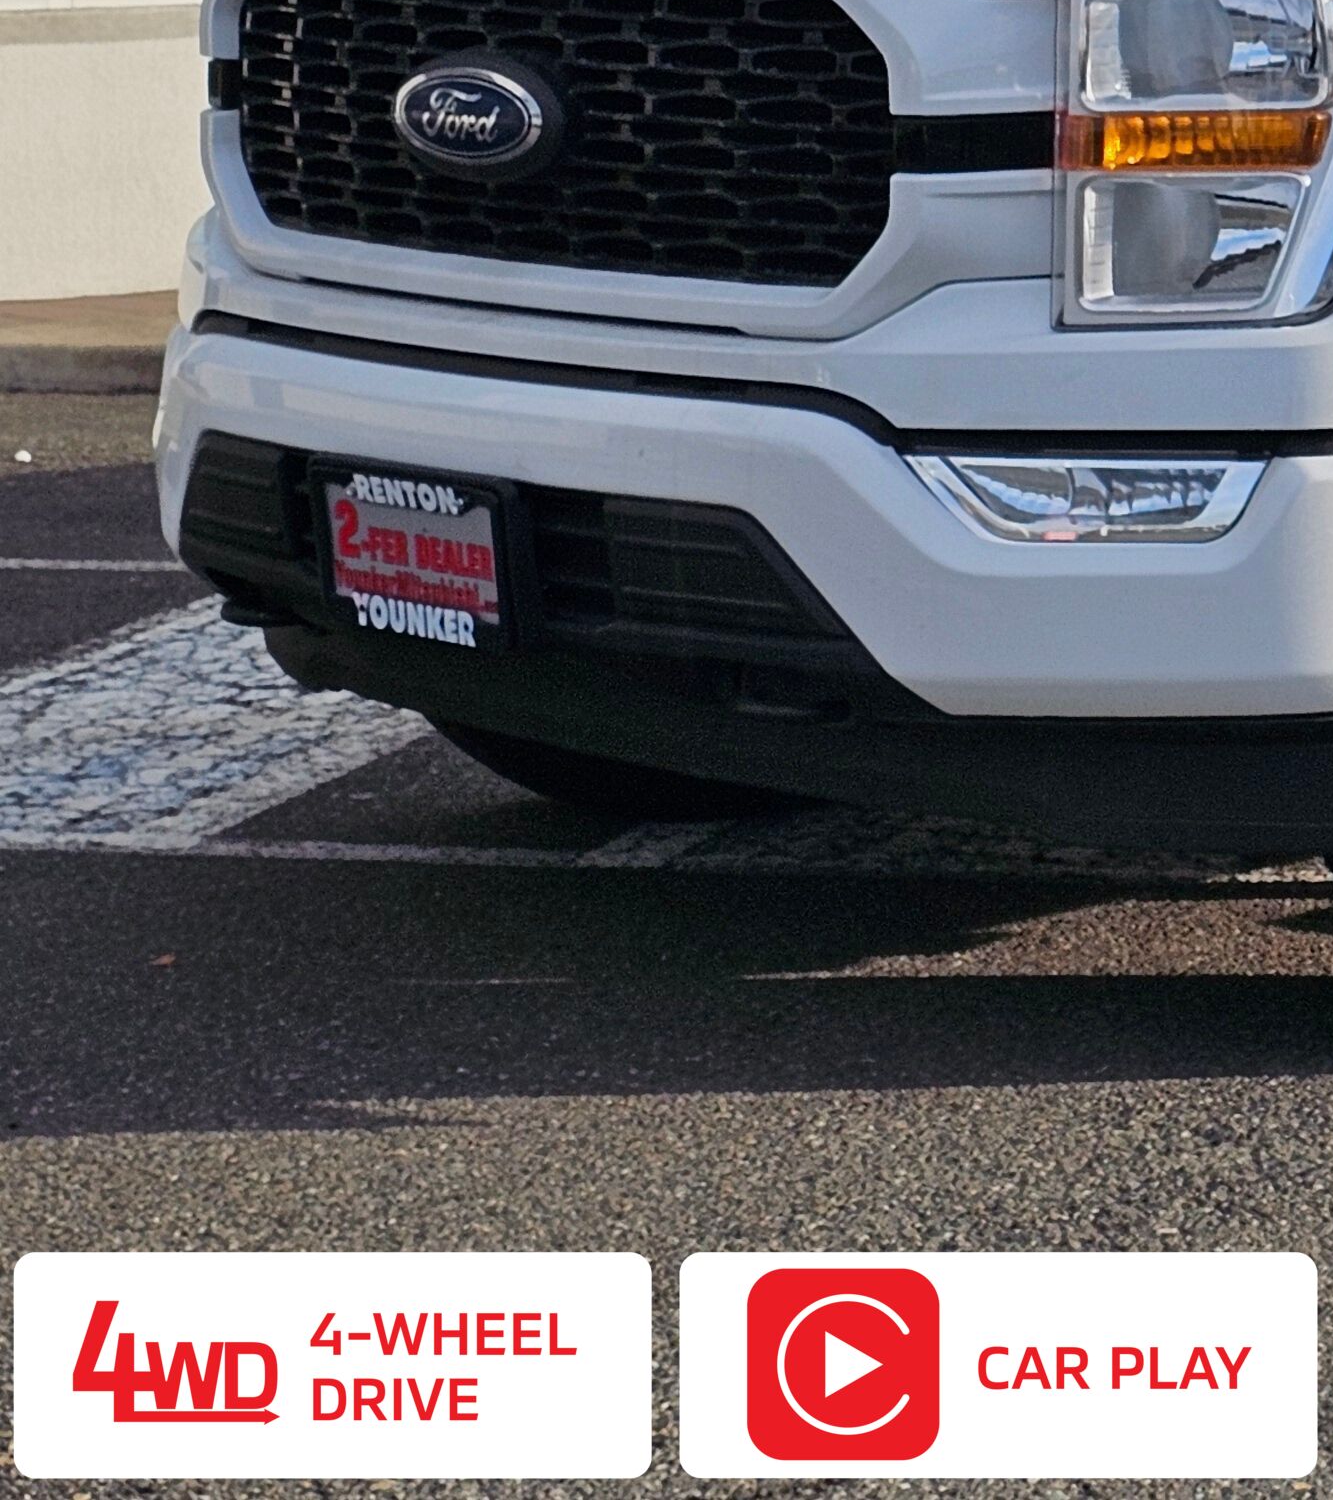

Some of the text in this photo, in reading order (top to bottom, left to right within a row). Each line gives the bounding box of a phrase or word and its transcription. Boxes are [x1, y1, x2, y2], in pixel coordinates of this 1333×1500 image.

[422, 87, 500, 143] Ford
[352, 474, 458, 515] RENTON
[335, 499, 495, 582] 2-FER DEALER
[351, 591, 476, 647] YOUNKER
